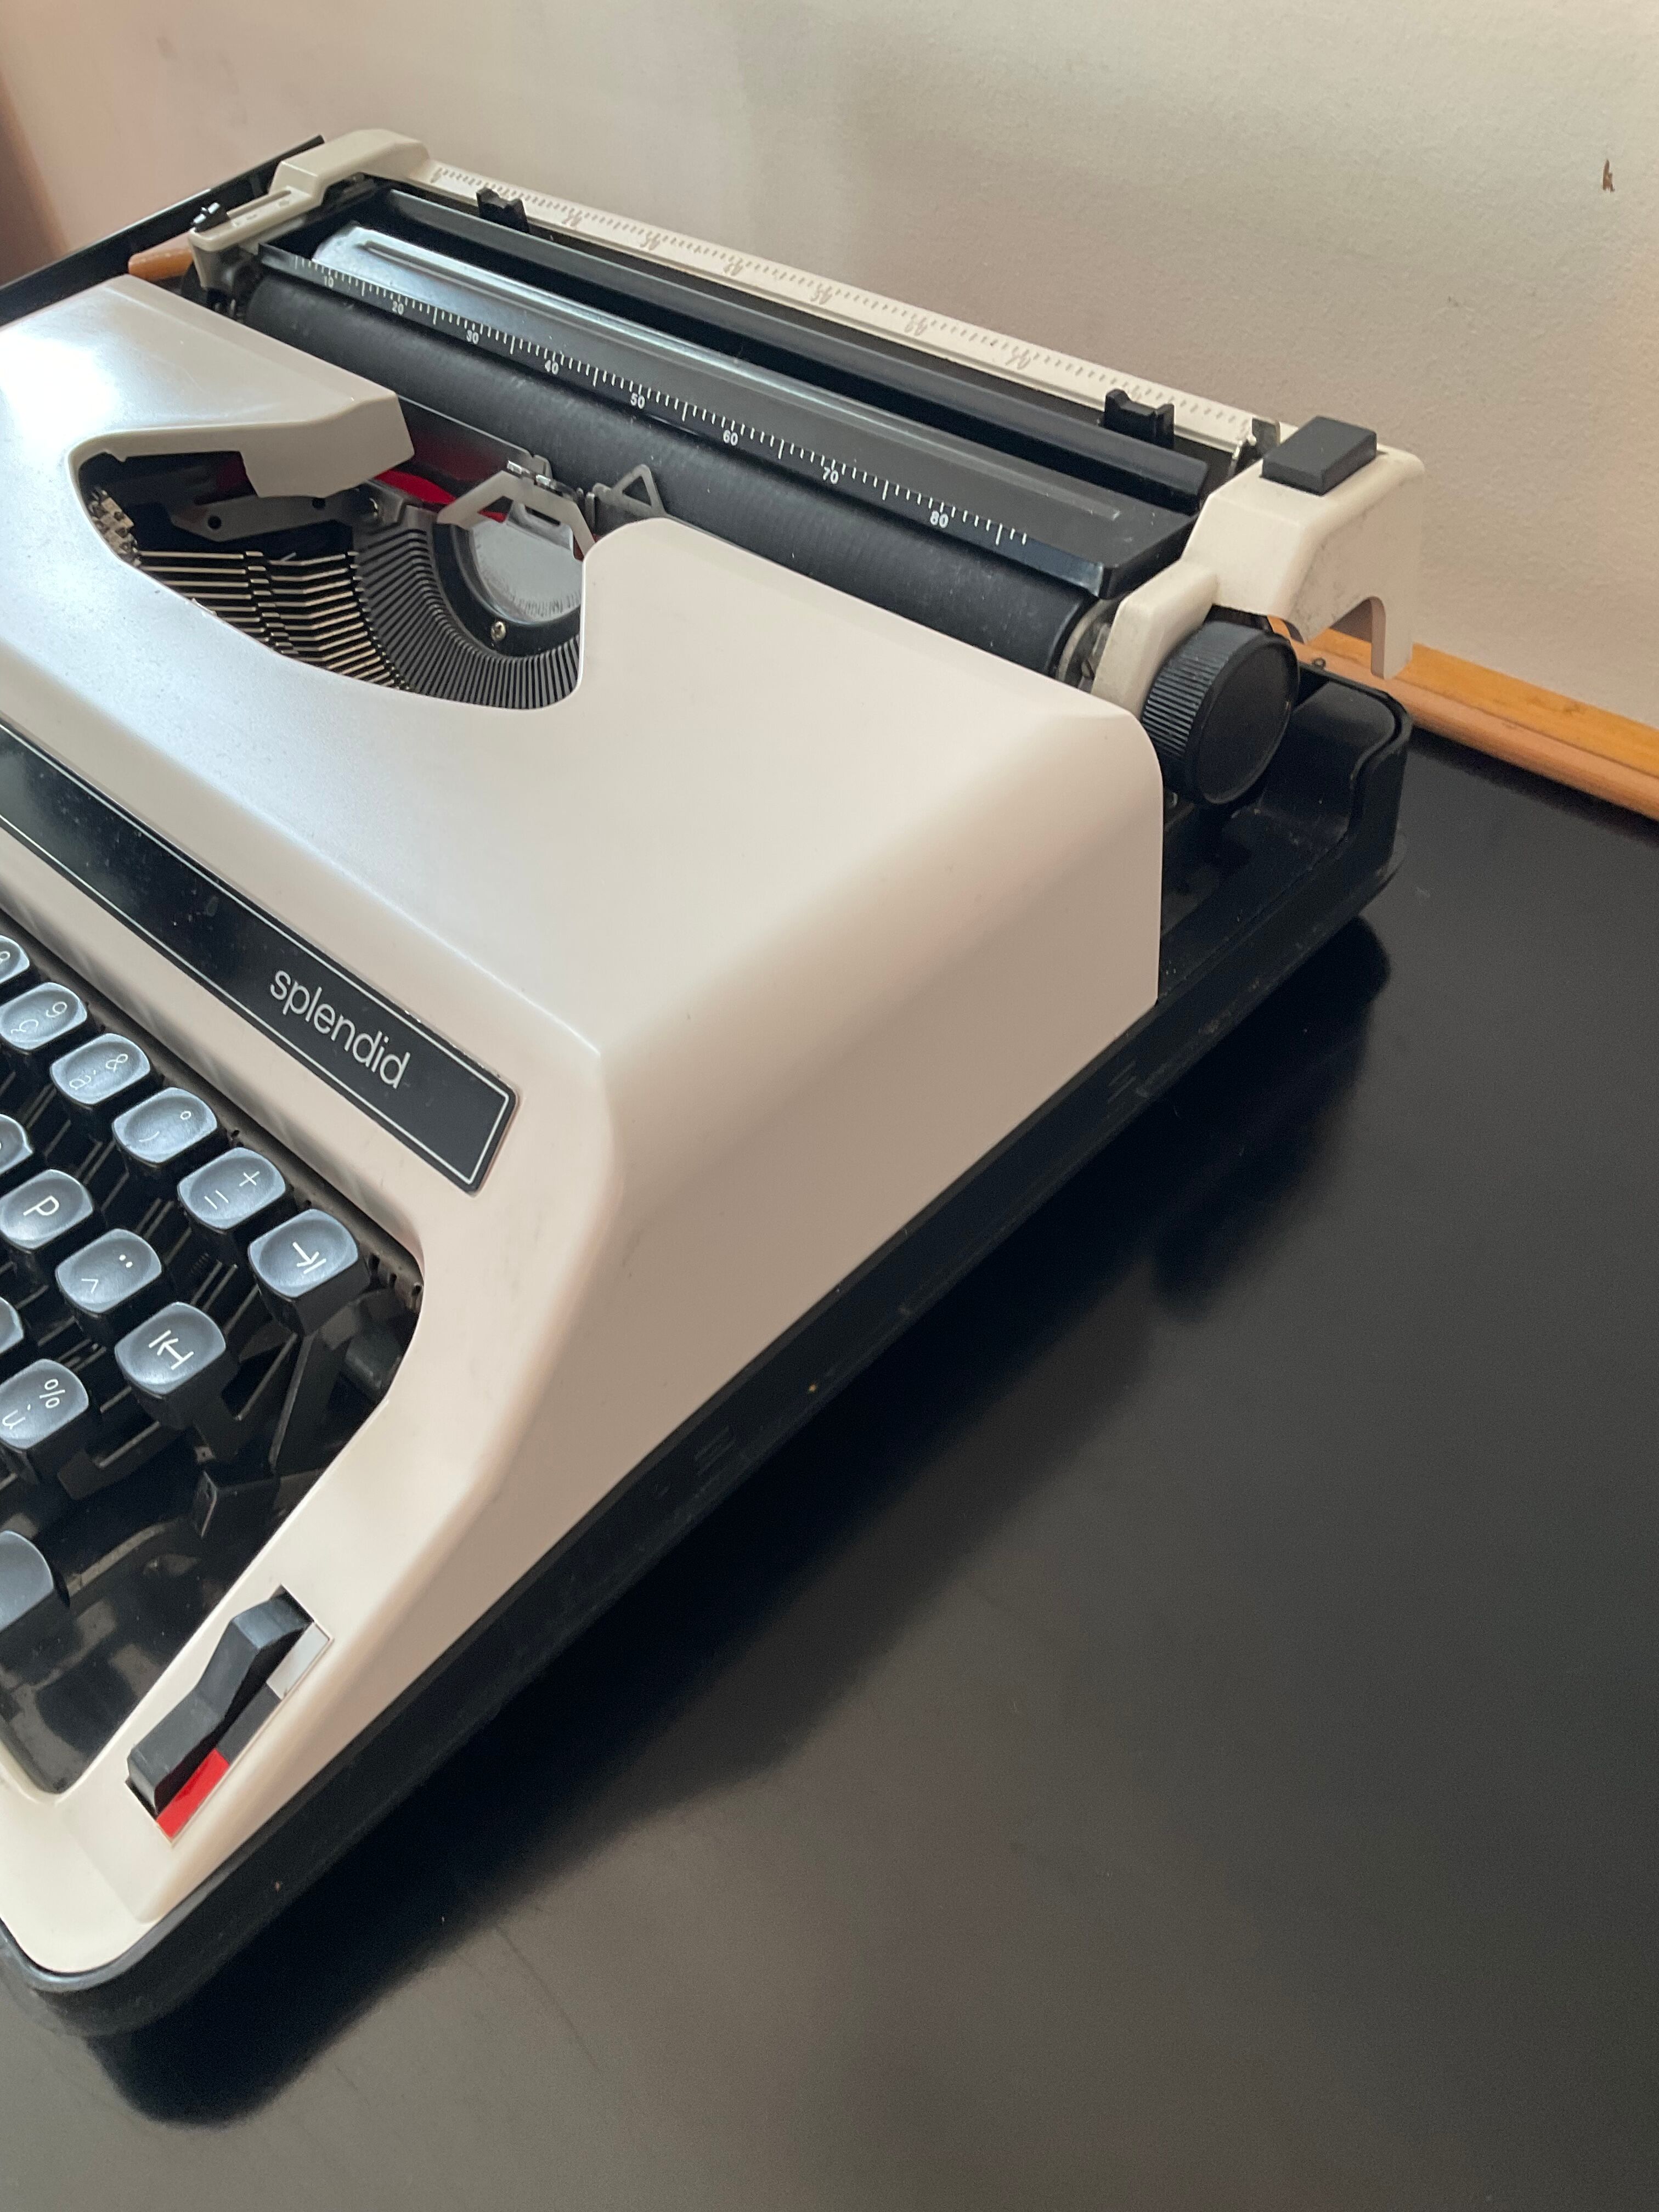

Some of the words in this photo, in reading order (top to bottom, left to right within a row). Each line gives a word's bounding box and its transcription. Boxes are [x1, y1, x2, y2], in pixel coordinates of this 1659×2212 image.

[324, 275, 334, 289] 10
[392, 301, 404, 315] 20
[466, 329, 479, 345] 30
[544, 359, 559, 375] 40
[630, 392, 646, 409] 50
[723, 430, 739, 447] 60
[822, 467, 839, 485] 70
[930, 510, 949, 529] 80
[46, 1001, 68, 1018] 9
[270, 969, 411, 1089] splendid
[239, 1170, 261, 1187] +
[23, 1195, 60, 1216] P
[39, 1378, 66, 1409] %
